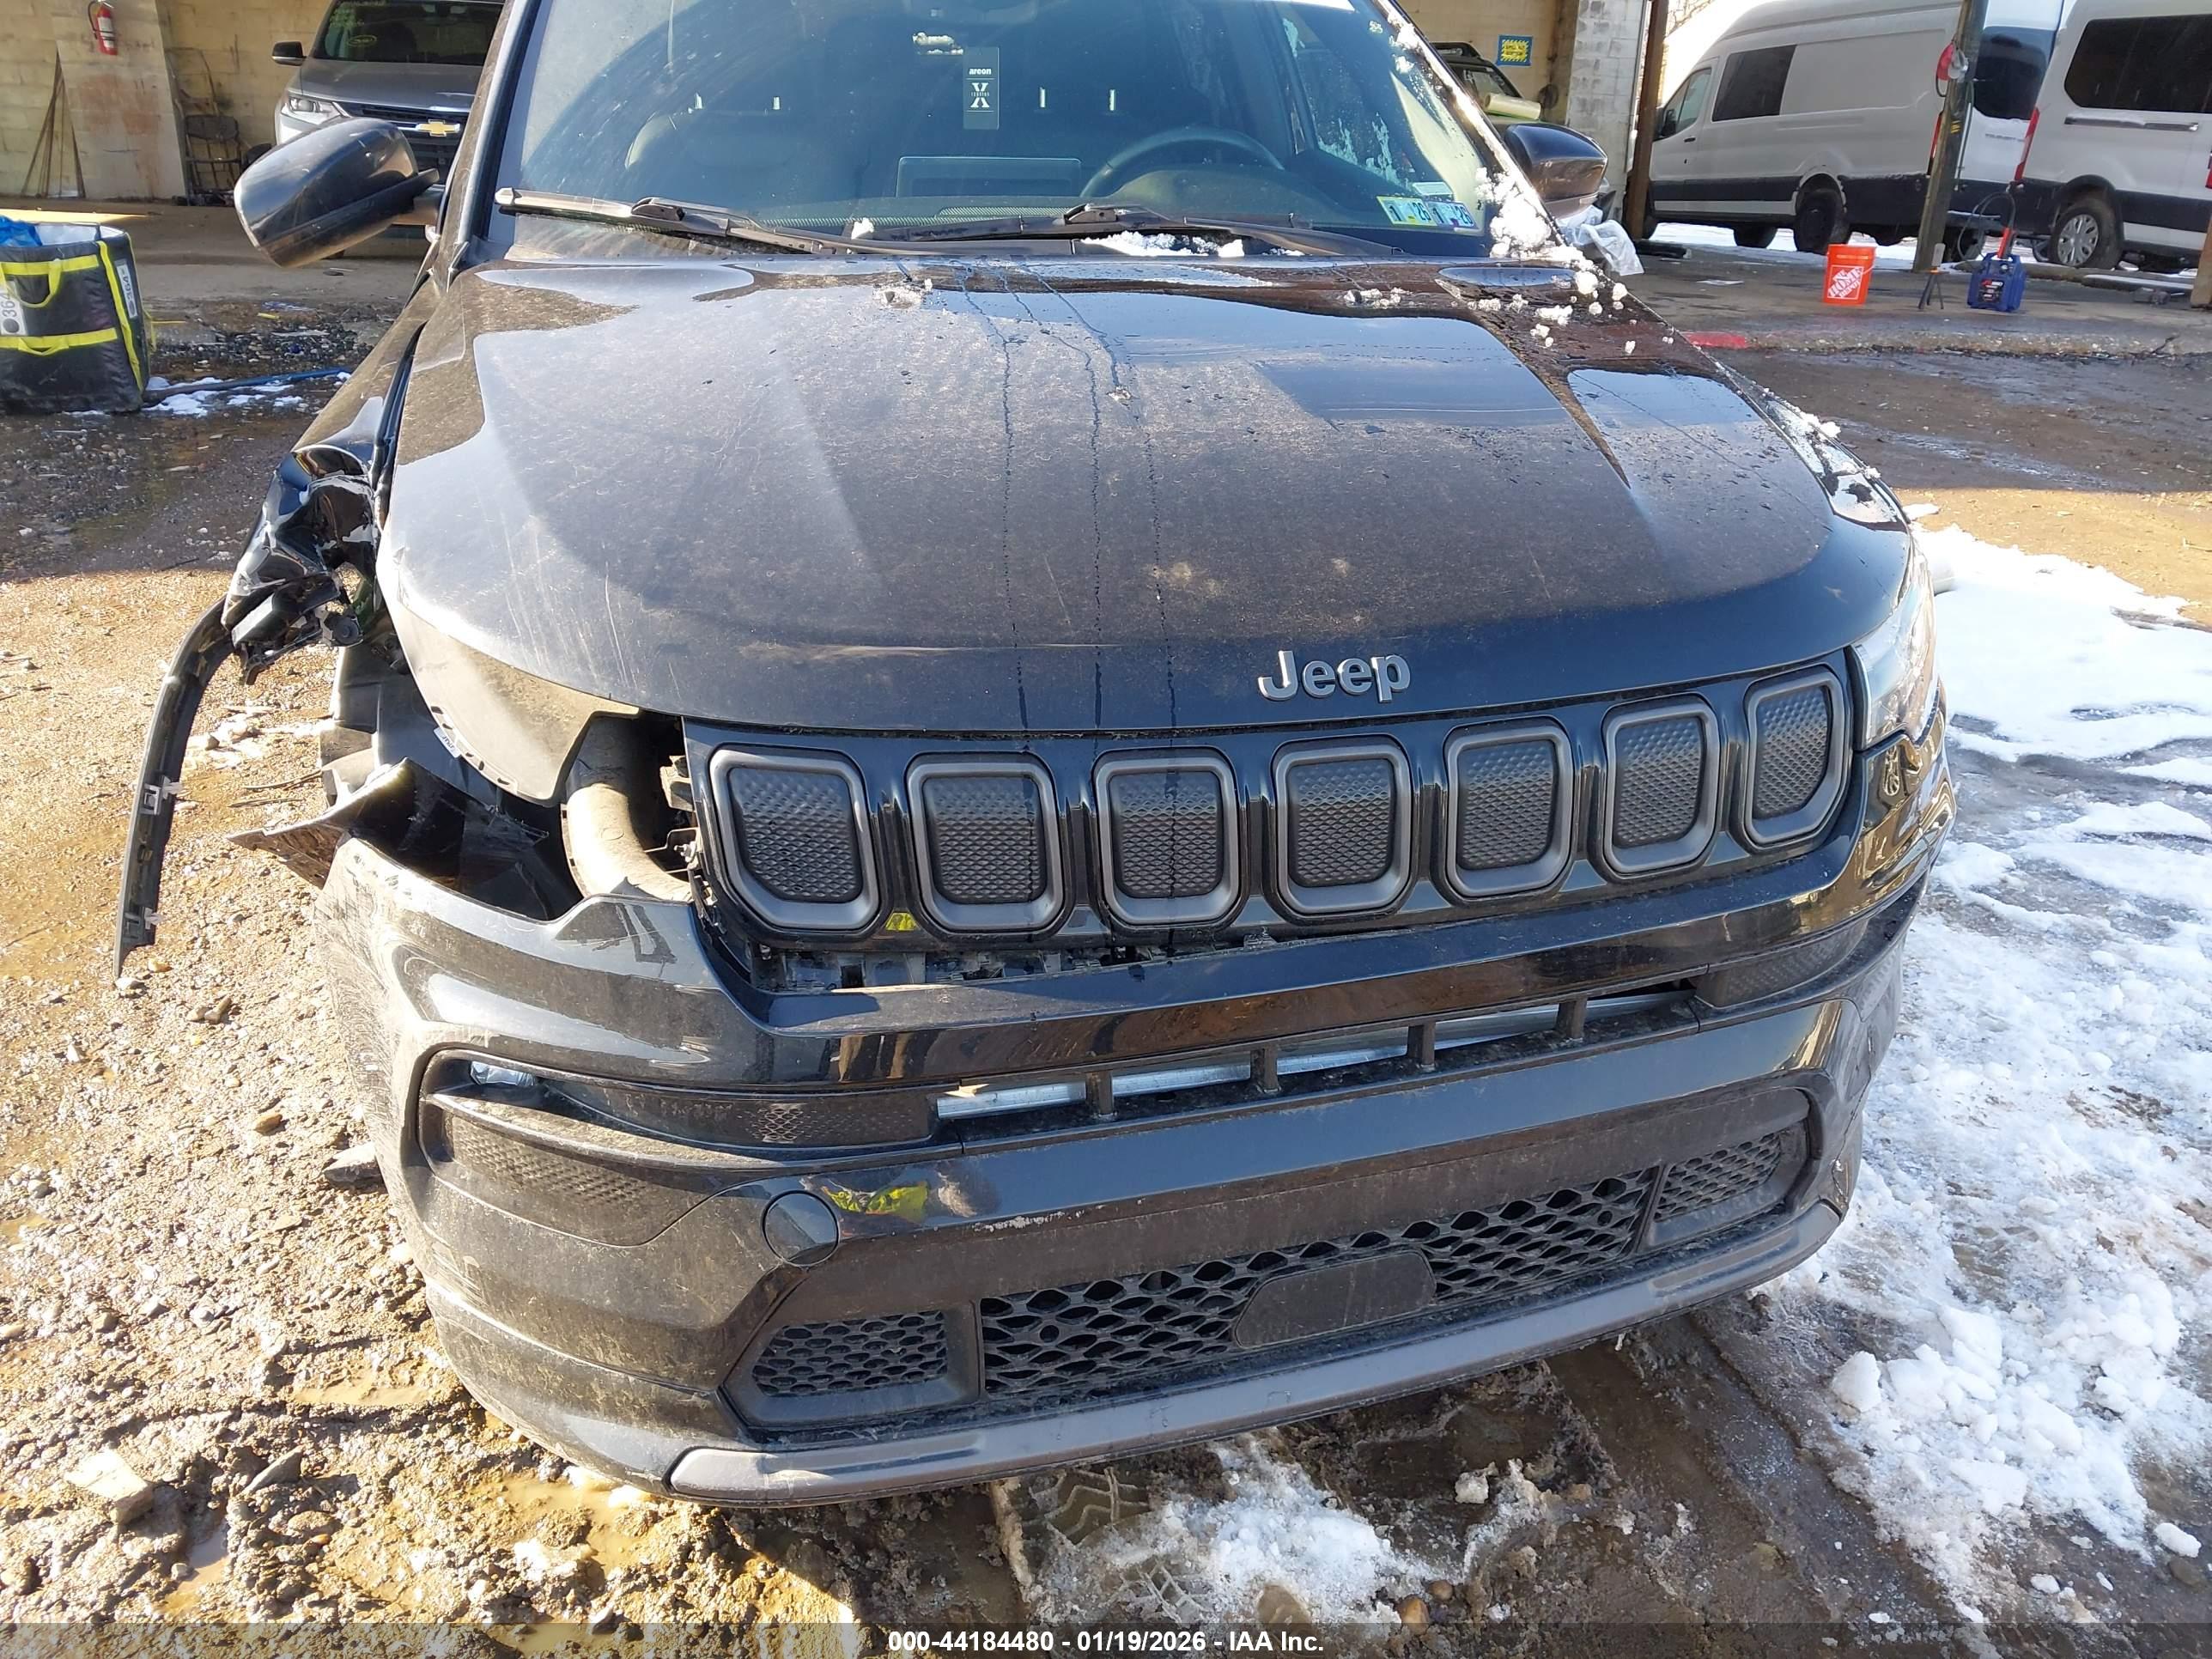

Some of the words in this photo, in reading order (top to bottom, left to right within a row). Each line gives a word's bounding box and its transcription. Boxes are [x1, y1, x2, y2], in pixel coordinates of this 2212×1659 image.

[1389, 204, 1402, 222] 1
[1412, 202, 1431, 221] 26
[1432, 207, 1444, 223] 1
[1455, 205, 1474, 224] 26
[1827, 266, 1863, 297] HOME
[1257, 650, 1411, 702] Jeep
